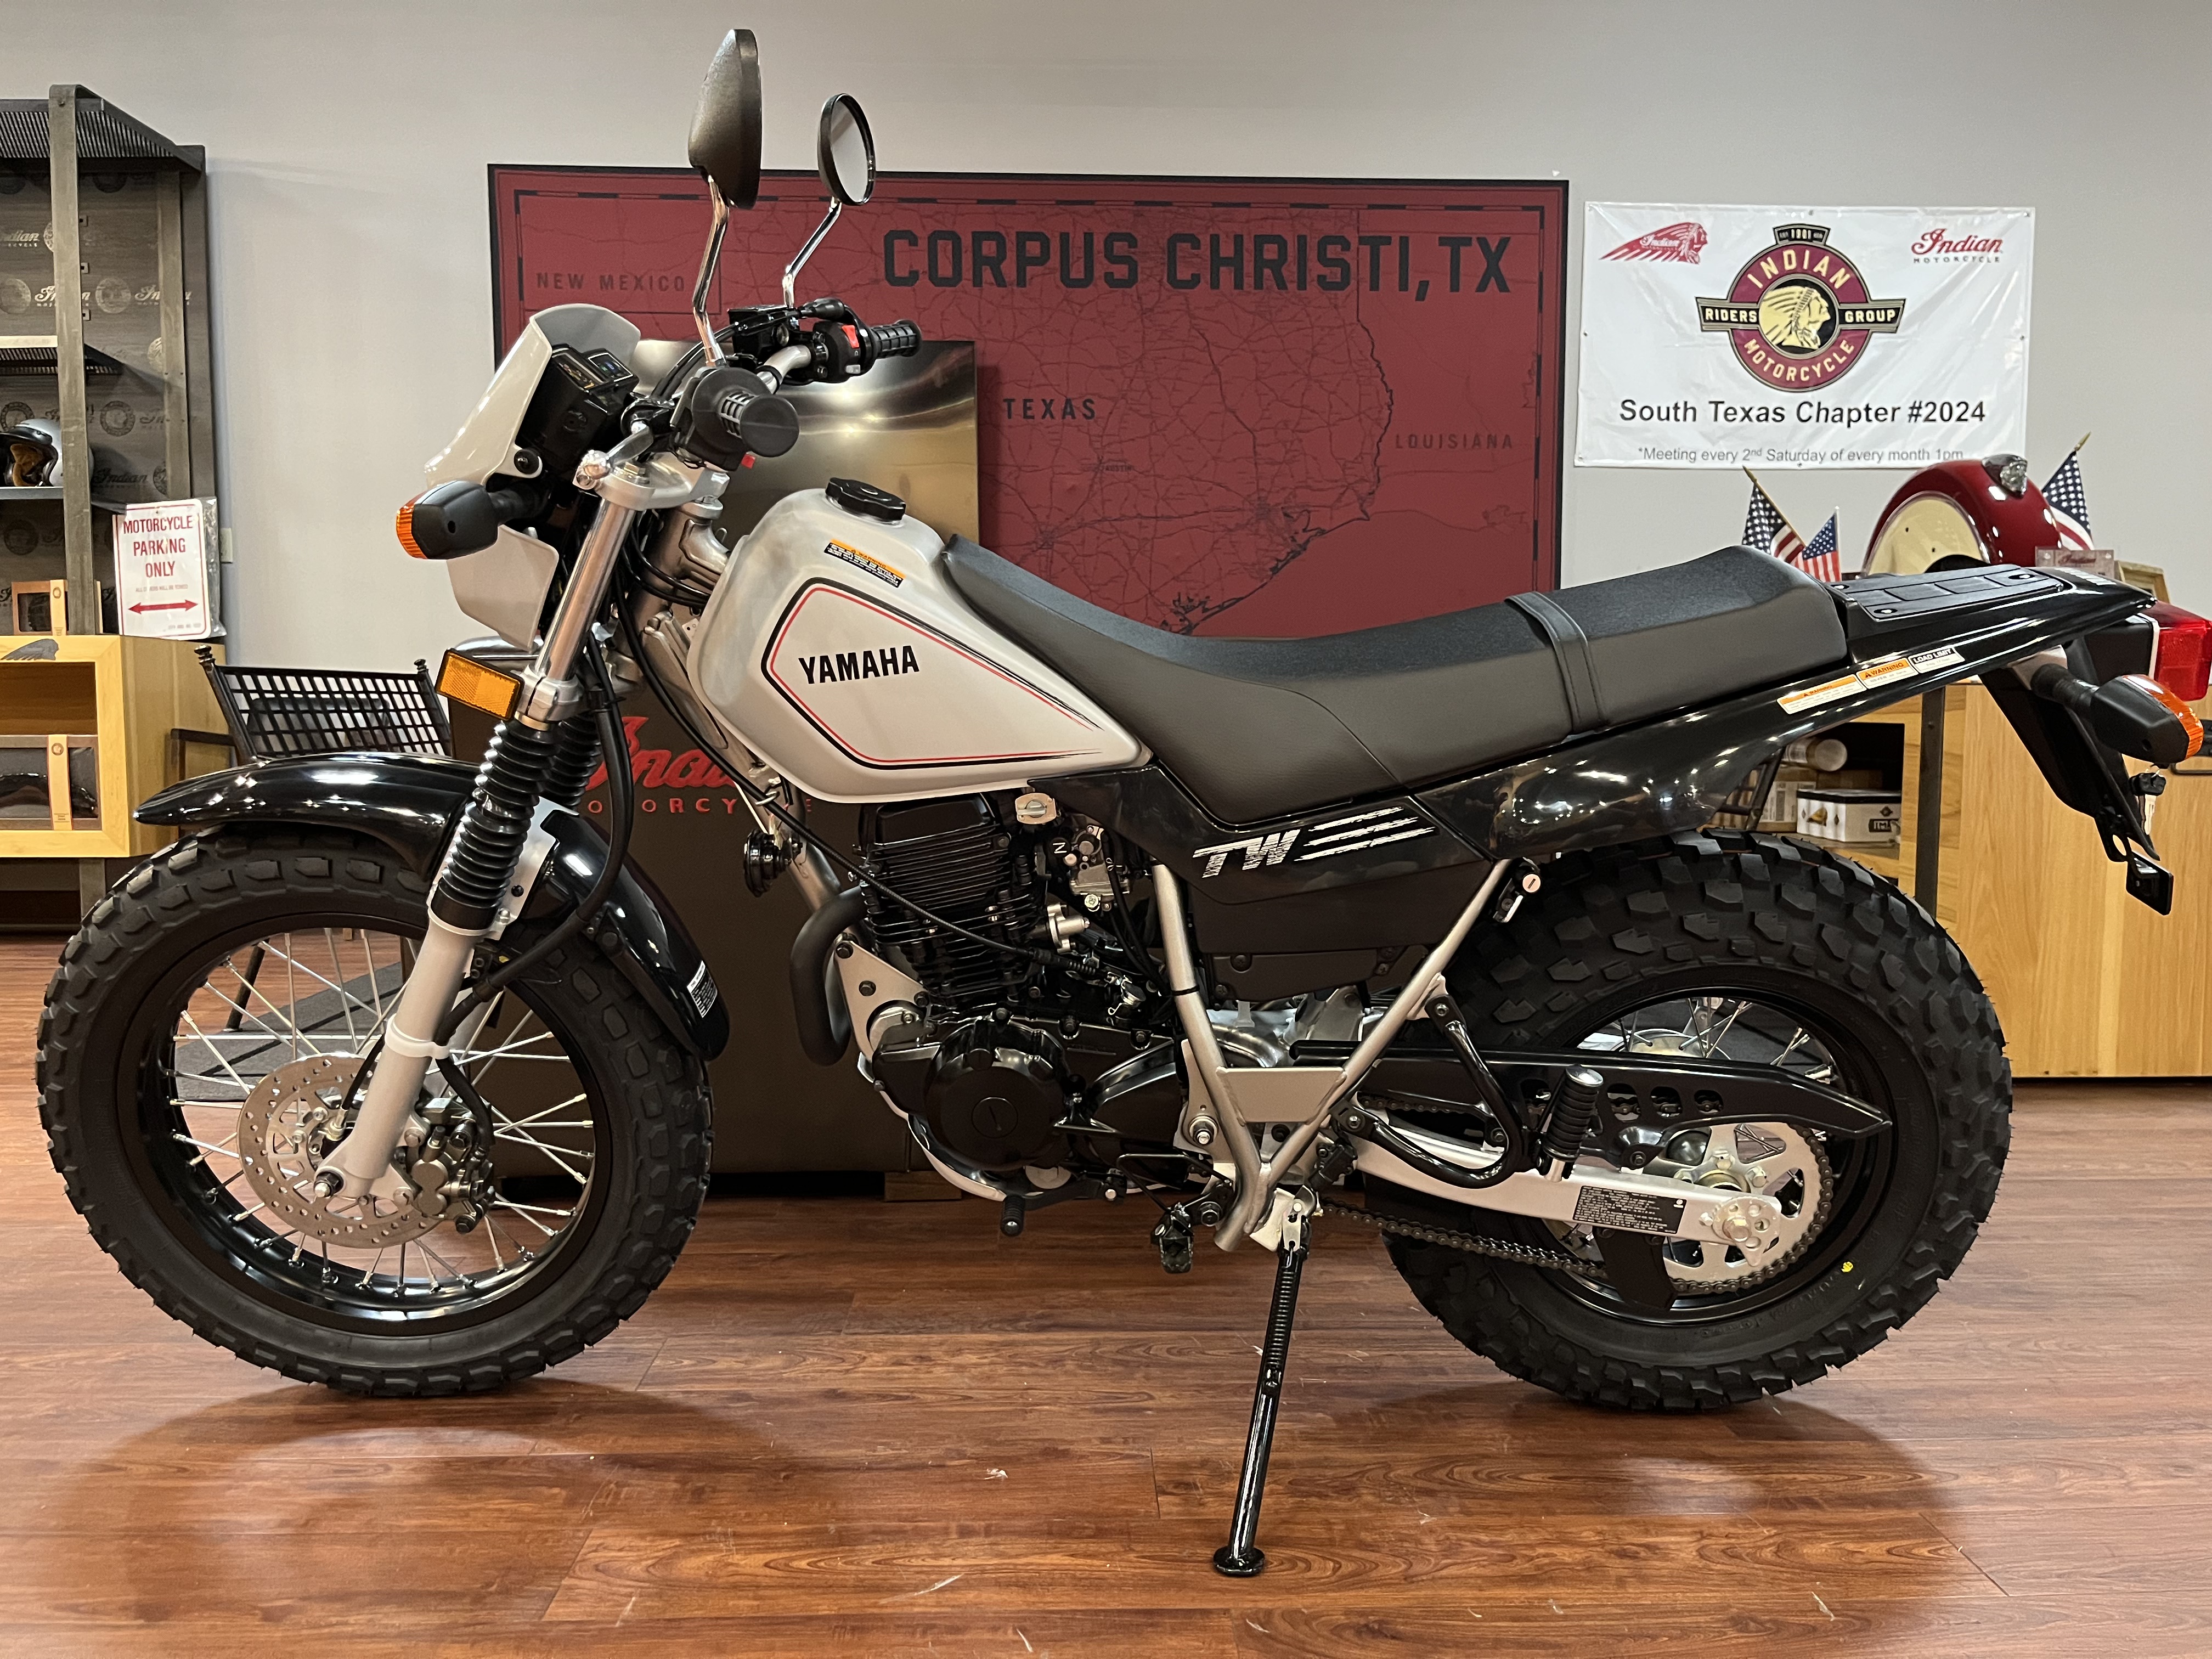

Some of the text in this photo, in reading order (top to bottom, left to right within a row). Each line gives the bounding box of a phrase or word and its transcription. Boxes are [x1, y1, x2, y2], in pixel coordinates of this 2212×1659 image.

[1911, 228, 2003, 255] Indian
[884, 230, 1139, 289] CORPUS
[1747, 249, 1851, 289] INDIAN
[536, 272, 685, 292] NEW MEXICO
[1705, 307, 1758, 323] RIDERS
[1844, 309, 1896, 323] GROUP
[1743, 338, 1855, 382] MOTORCYCLE
[1003, 398, 1096, 420] TEXAS
[1620, 399, 1986, 428] South Texas Chapter #2024
[1395, 433, 1513, 449] LOUISIANA
[1701, 449, 1738, 464] every
[1742, 447, 1762, 461] 2nd
[1767, 448, 1826, 464] Saturday
[1831, 448, 1844, 460] of
[1847, 450, 1884, 464] every
[1888, 448, 1931, 460] month
[1936, 448, 1963, 460] 1pm
[123, 515, 193, 534] MOTORCYCLE
[133, 538, 186, 556] PARKING
[145, 561, 176, 578] ONLY
[859, 552, 887, 569] WARNING
[798, 645, 920, 684] YAMAHA
[1913, 653, 1933, 663] LOAD
[1933, 648, 1952, 658] LIMIT
[1871, 662, 1904, 675] WARNING
[1193, 829, 1301, 878] TW
